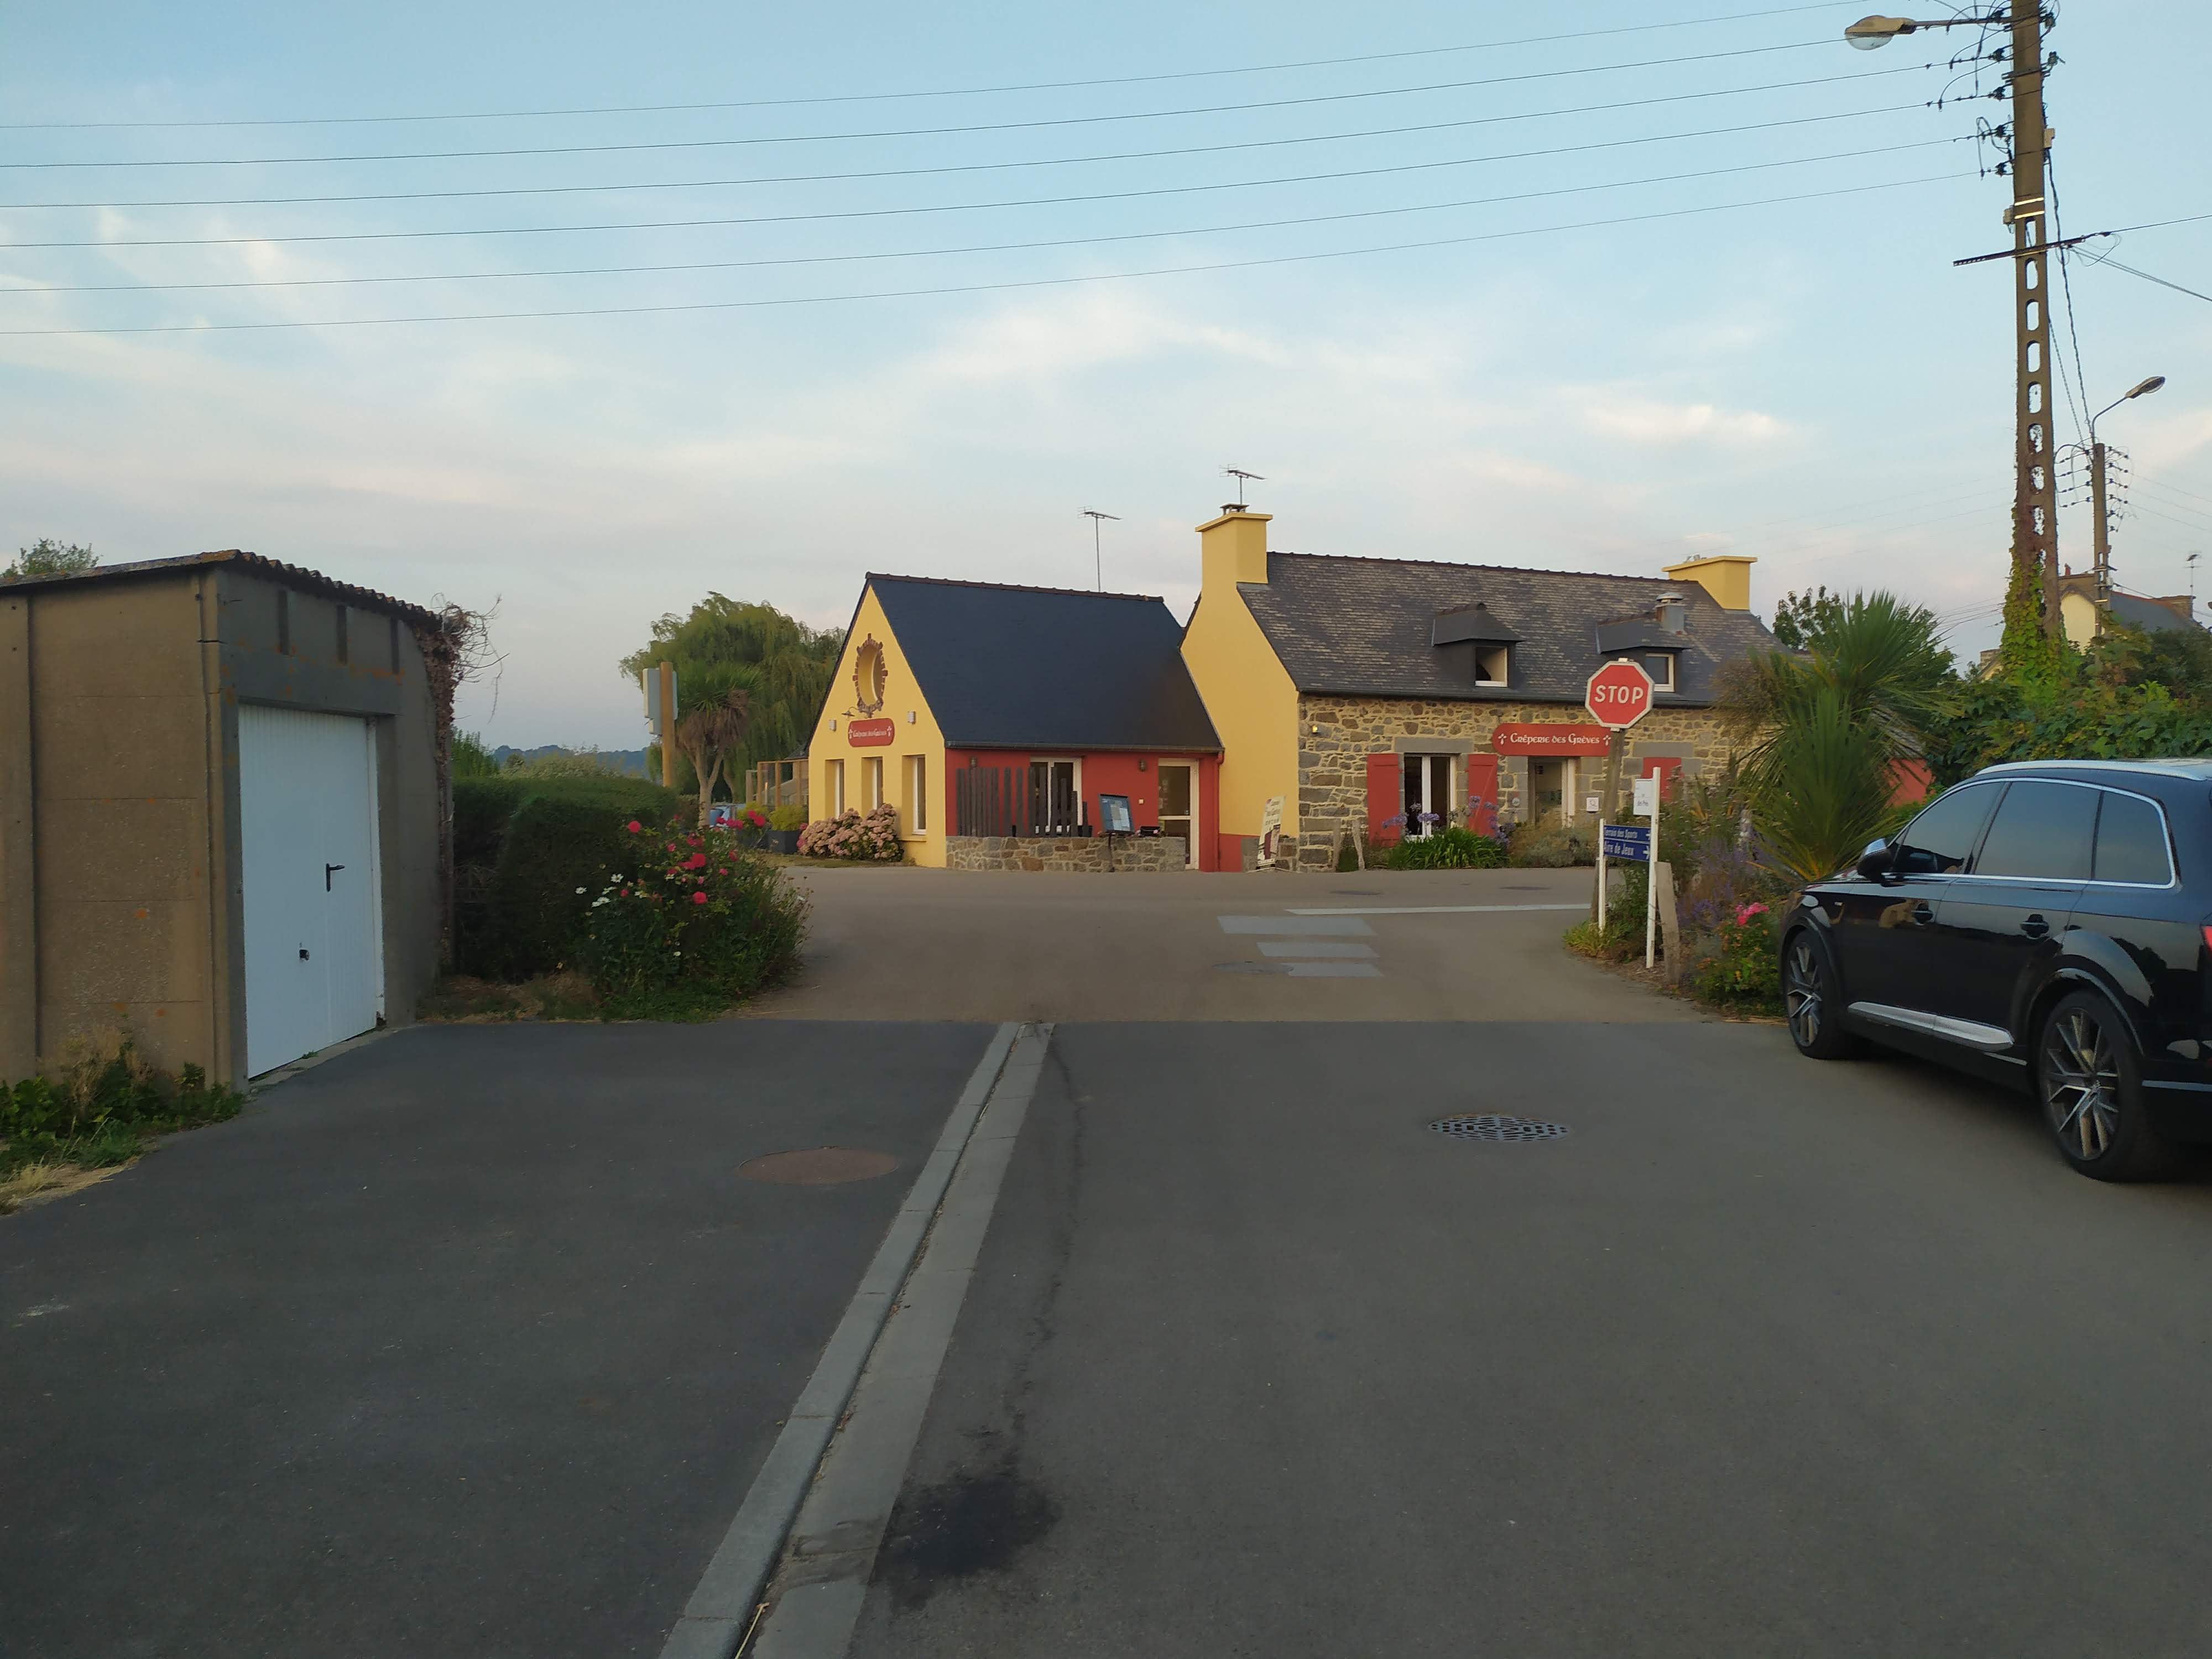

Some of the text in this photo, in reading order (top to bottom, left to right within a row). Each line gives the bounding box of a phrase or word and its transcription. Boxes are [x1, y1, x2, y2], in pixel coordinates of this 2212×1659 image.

[1594, 685, 1644, 704] STOP
[1614, 842, 1621, 854] de
[1621, 843, 1634, 856] Jeux
